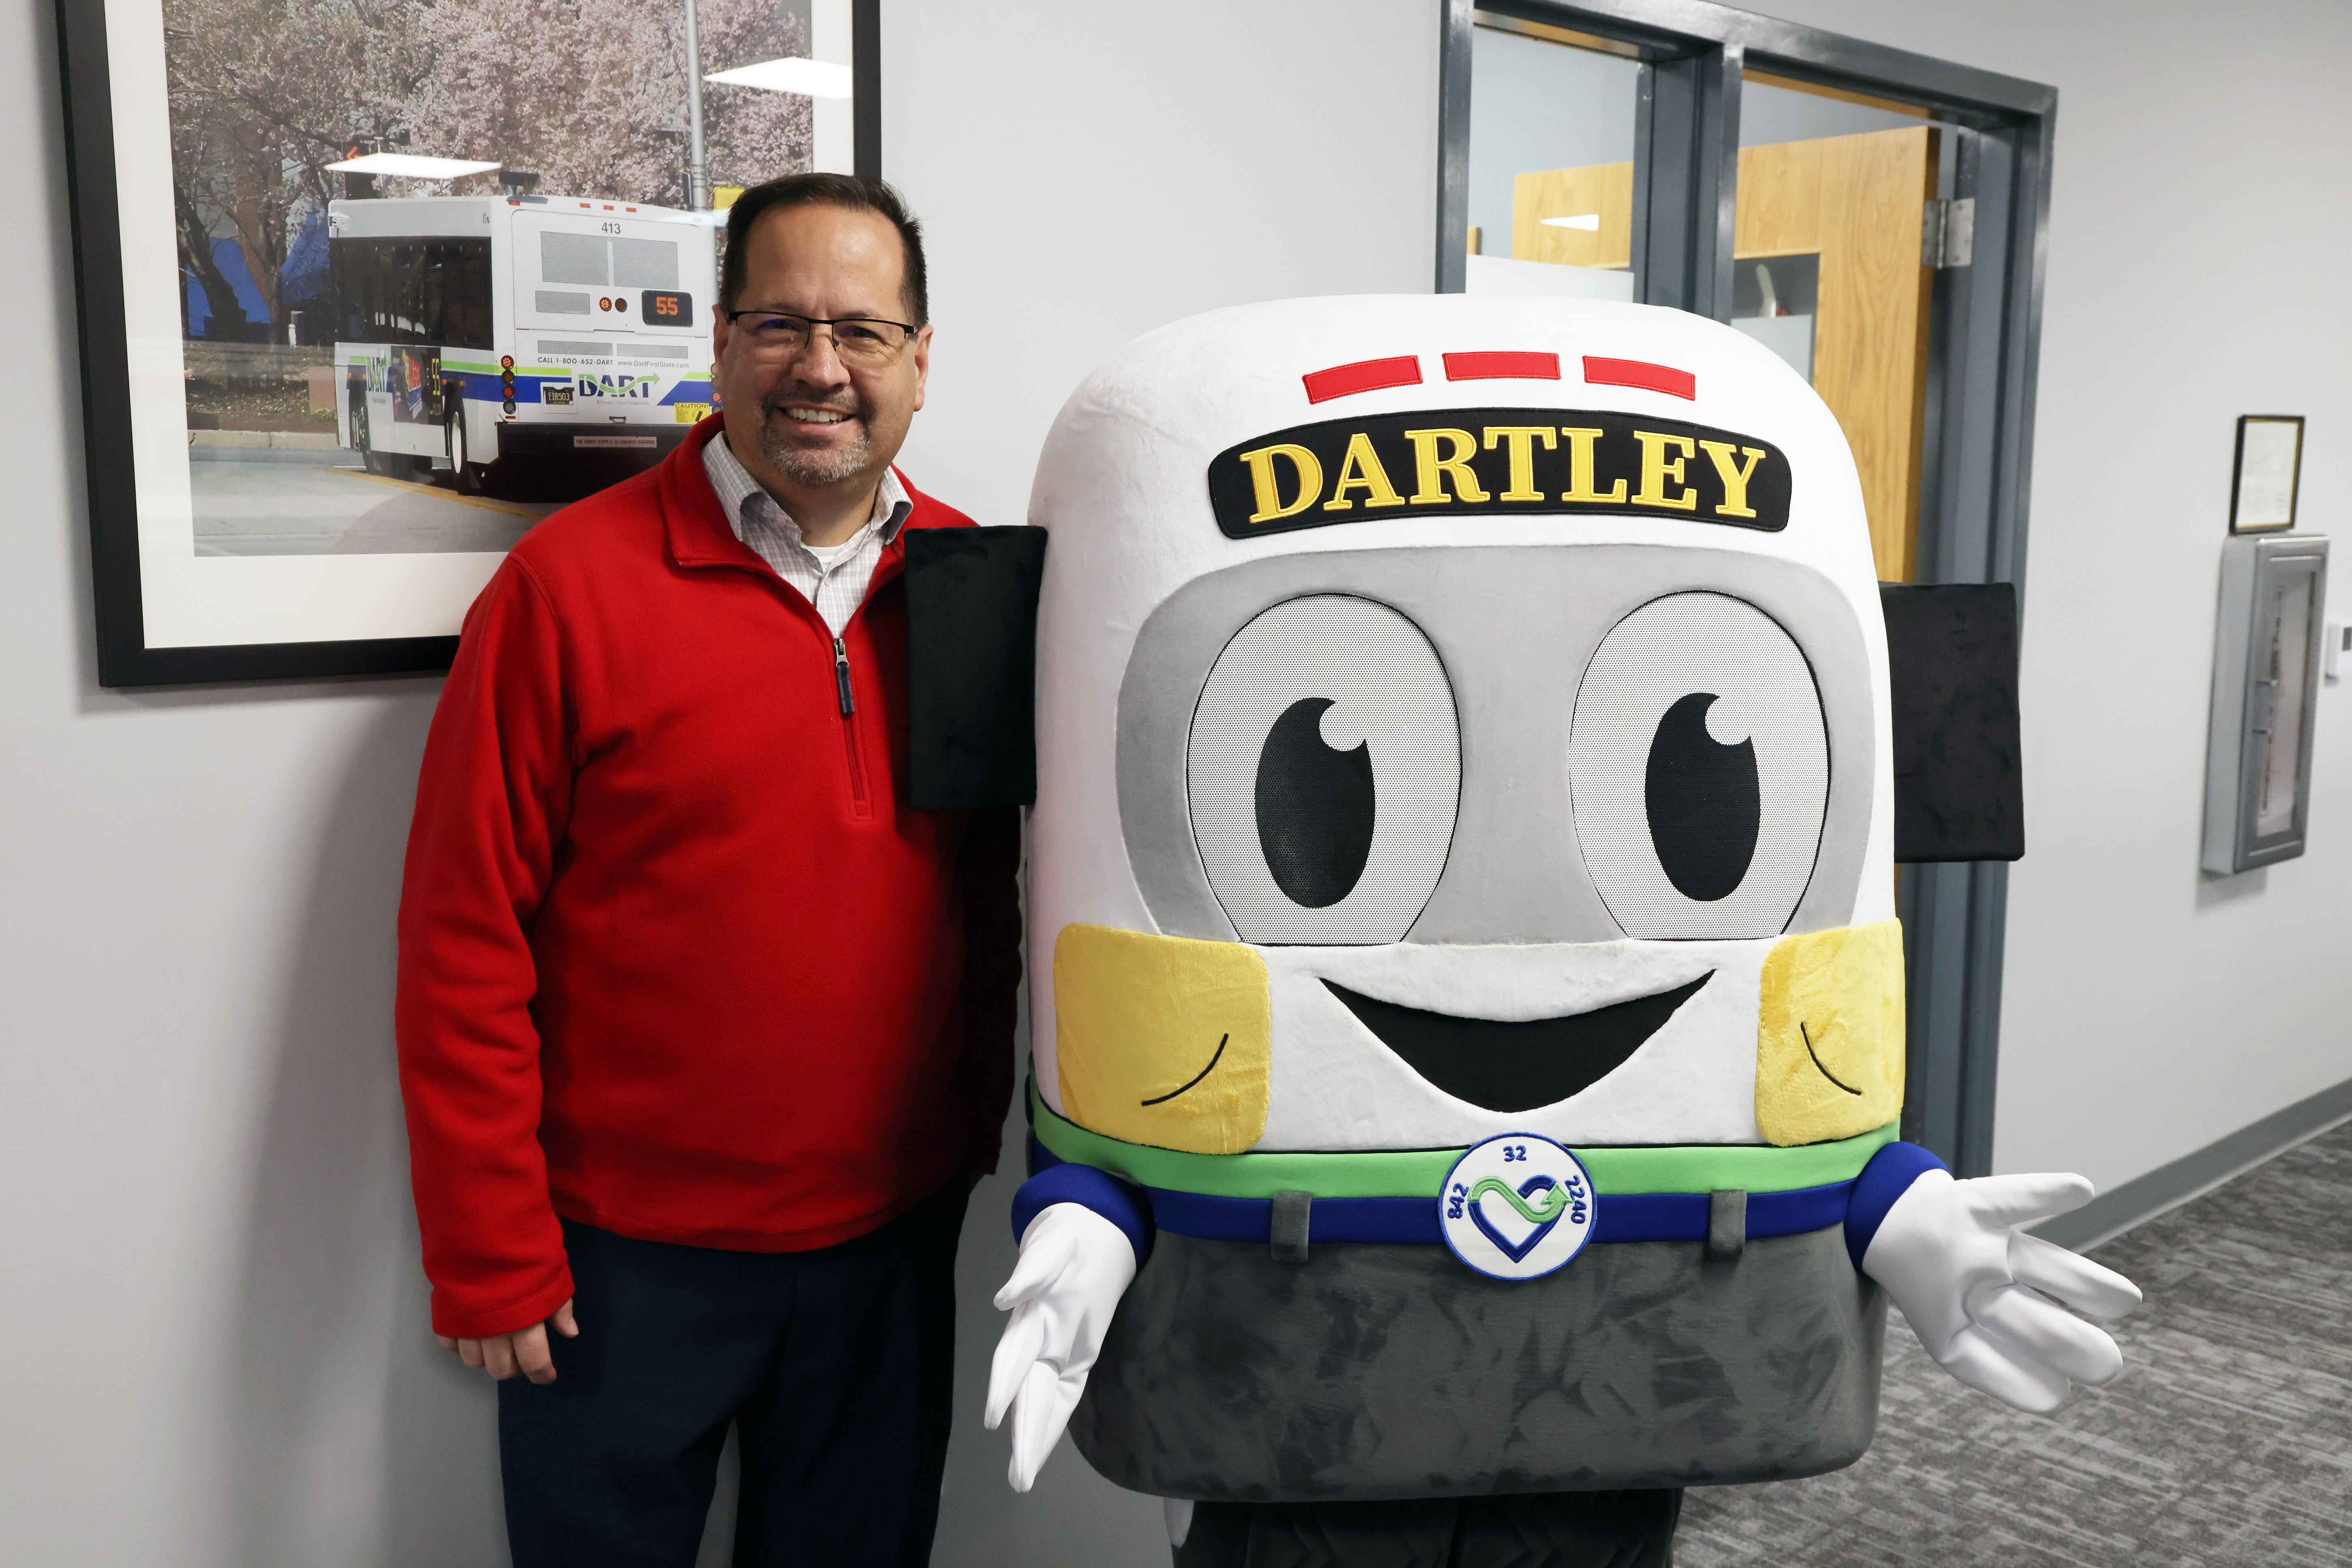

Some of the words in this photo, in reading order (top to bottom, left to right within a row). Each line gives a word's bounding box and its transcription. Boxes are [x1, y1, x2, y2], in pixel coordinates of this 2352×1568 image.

[601, 222, 621, 234] 413
[656, 296, 678, 315] 55
[578, 373, 660, 398] DART
[1239, 426, 1766, 524] DARTLEY
[1503, 1145, 1527, 1162] 32
[1447, 1182, 1470, 1219] 842
[1564, 1174, 1587, 1224] 2240
